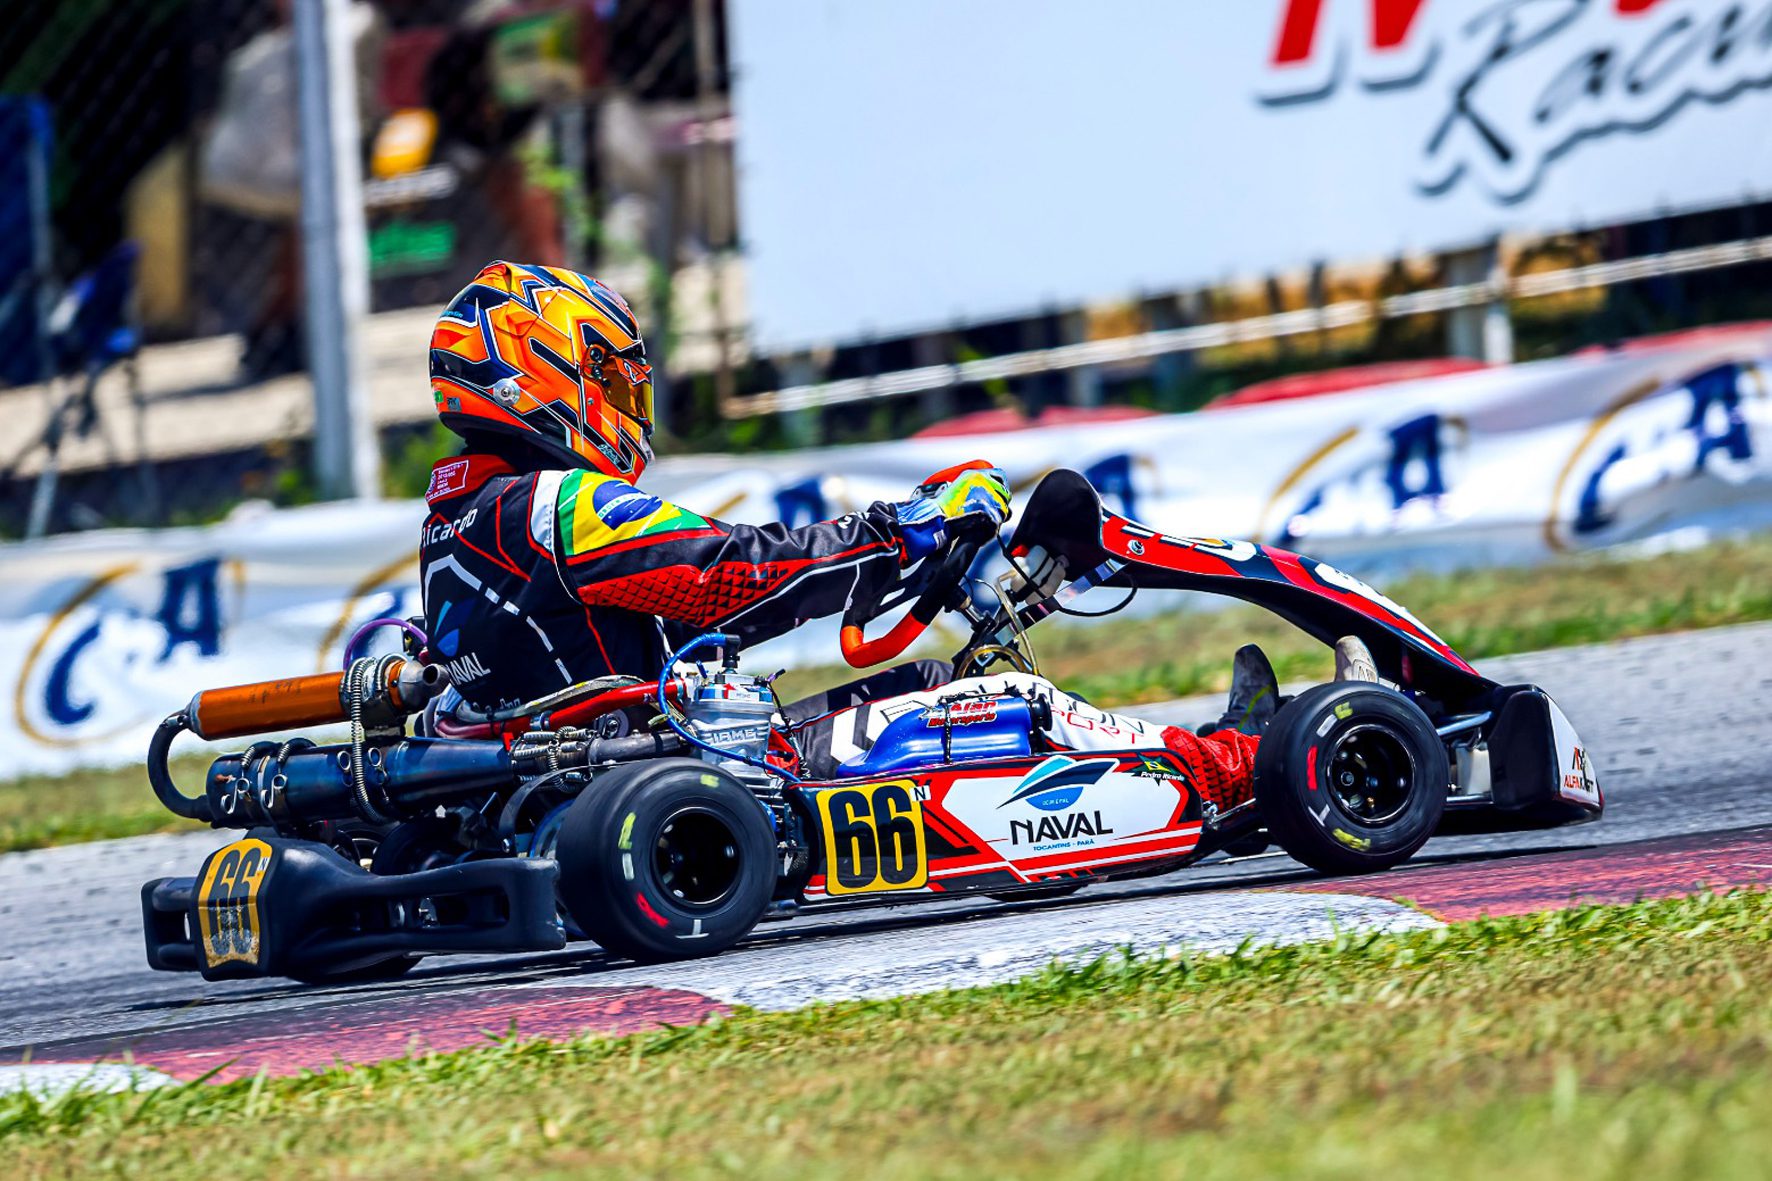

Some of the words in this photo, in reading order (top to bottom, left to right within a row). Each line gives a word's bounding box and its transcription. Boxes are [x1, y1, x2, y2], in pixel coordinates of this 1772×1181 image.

[713, 728, 757, 745] IAME
[914, 787, 926, 800] N
[827, 784, 919, 889] 66
[1009, 810, 1114, 846] NAVAL
[1033, 842, 1072, 851] TOCANTINS
[207, 847, 262, 956] 66
